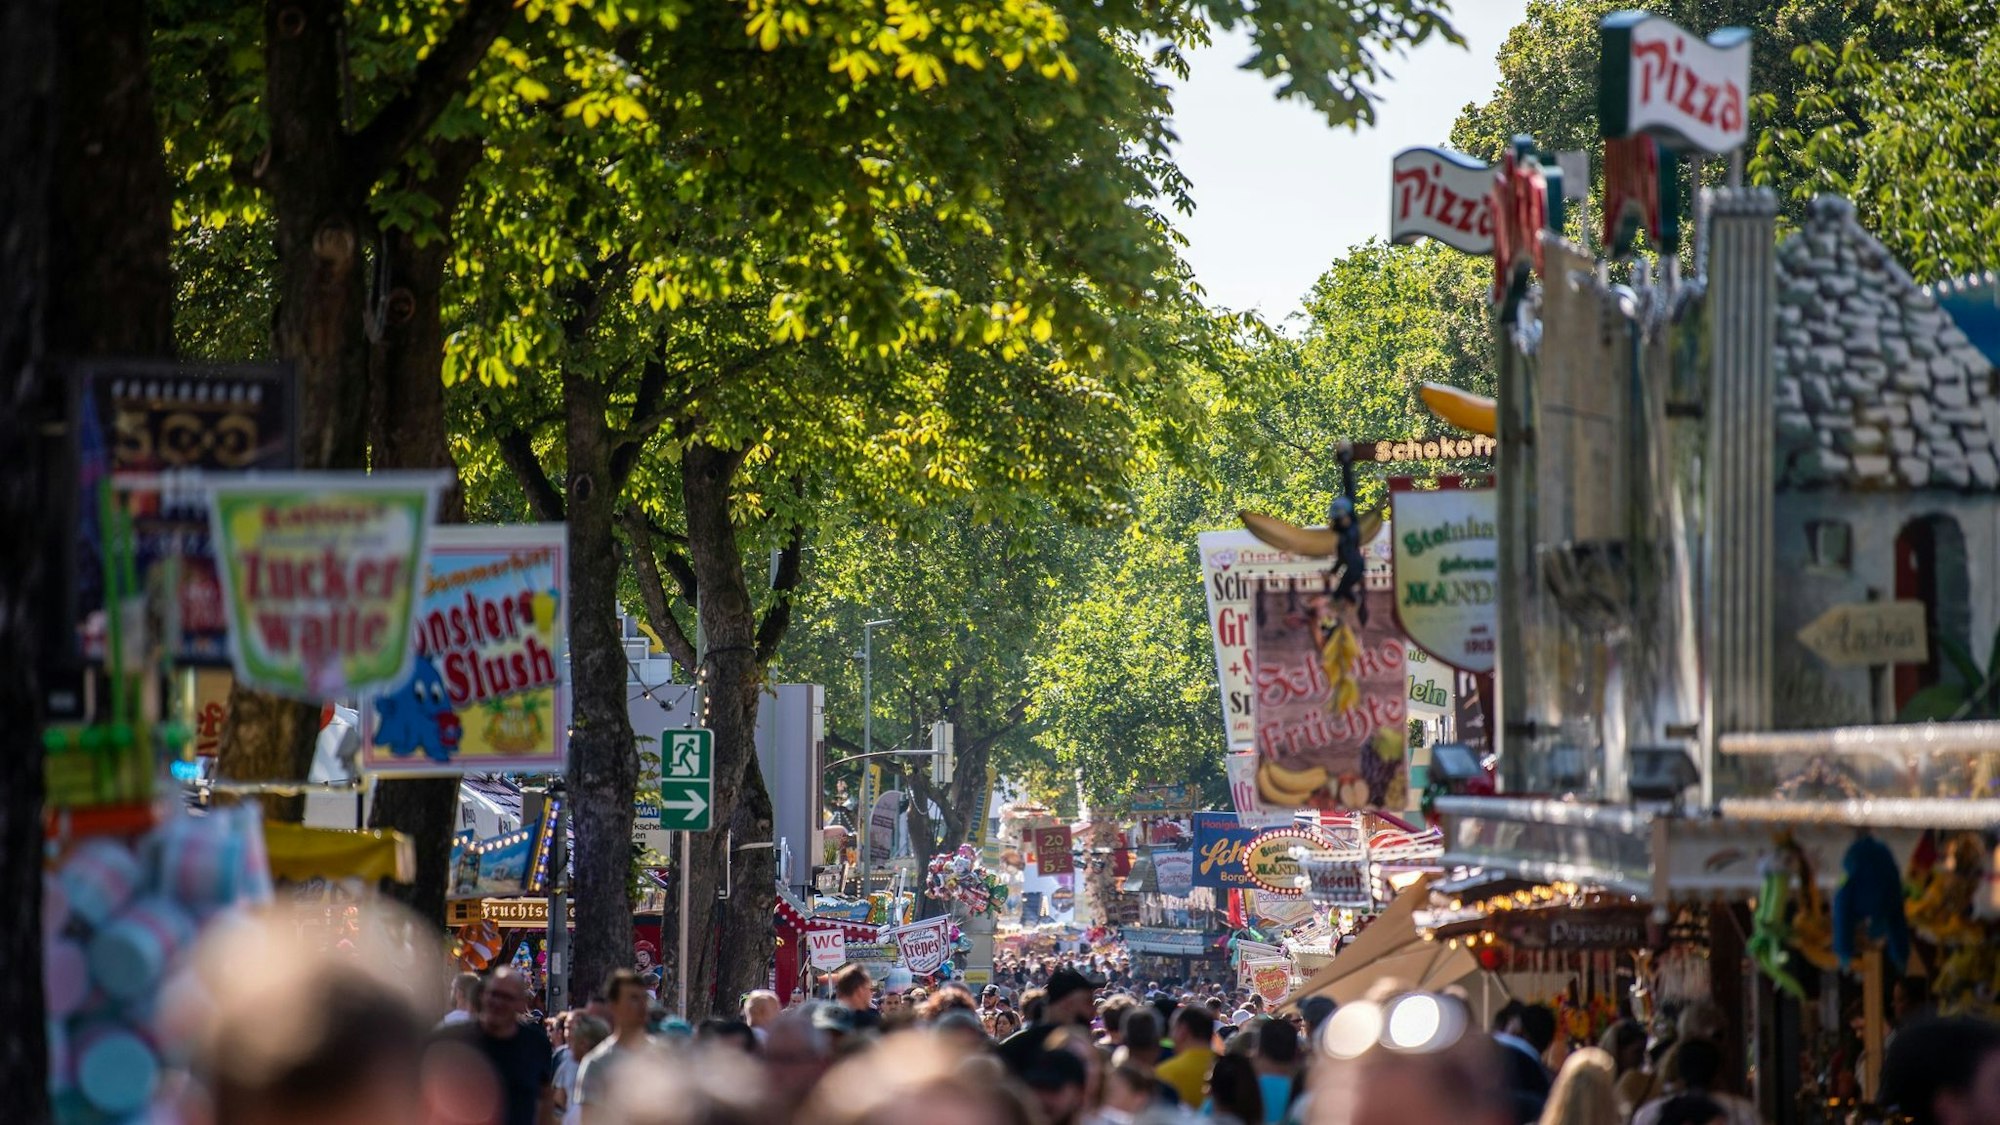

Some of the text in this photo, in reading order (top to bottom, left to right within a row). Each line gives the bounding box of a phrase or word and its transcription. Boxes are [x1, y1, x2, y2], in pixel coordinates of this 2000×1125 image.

[1632, 36, 1742, 134] Pizza
[242, 546, 406, 601] Zucker
[444, 636, 558, 705] Slush
[1260, 696, 1404, 760] Früchte
[1044, 834, 1064, 847] 20
[813, 934, 842, 949] WC
[902, 939, 939, 958] Crêpes
[1551, 918, 1643, 946] Popcorn
